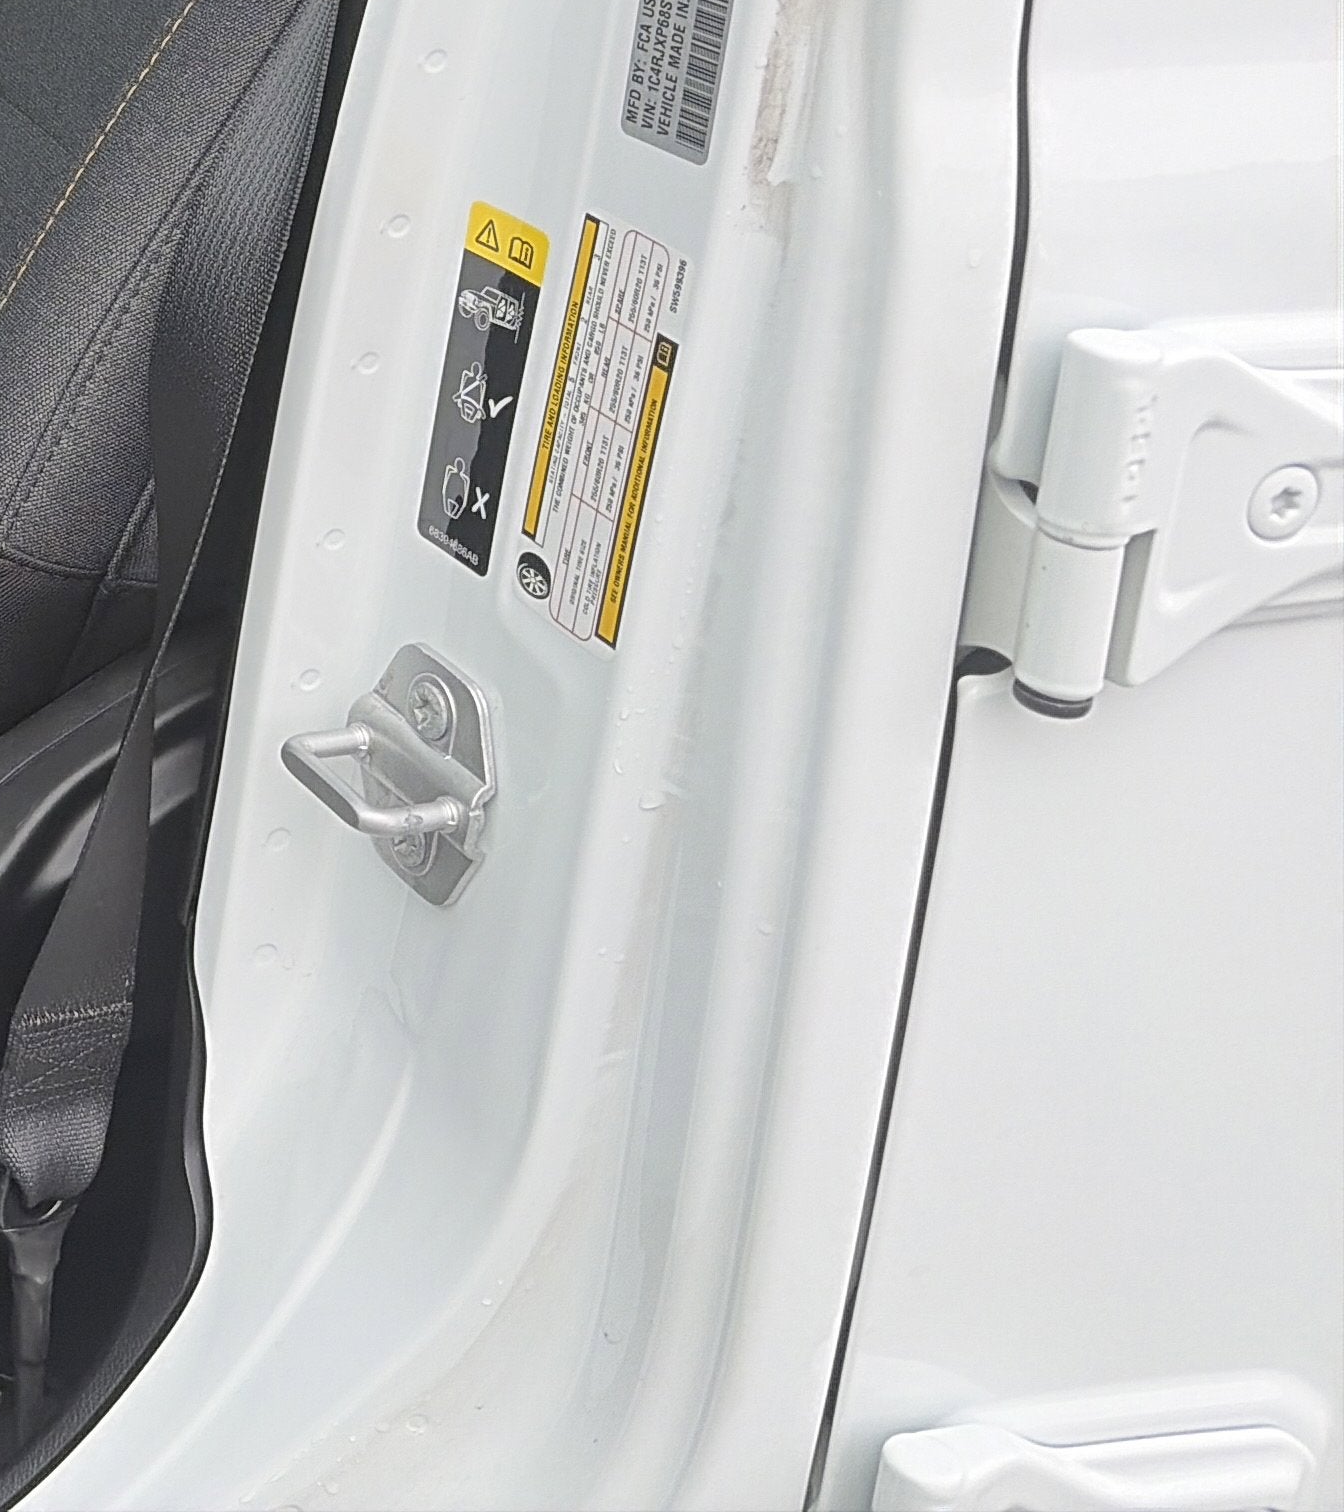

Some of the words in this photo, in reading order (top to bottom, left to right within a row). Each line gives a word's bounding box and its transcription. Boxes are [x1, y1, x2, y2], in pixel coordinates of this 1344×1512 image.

[636, 20, 652, 53] FCA
[631, 57, 646, 85] BY:
[656, 71, 678, 138] VEHICLE
[667, 22, 685, 69] MADE
[625, 87, 641, 123] MFD
[640, 96, 656, 131] VIN:
[605, 226, 616, 260] EXCEED
[598, 258, 610, 287] NEVER
[636, 253, 648, 276] 113T
[592, 286, 603, 320] SHOULD
[613, 287, 625, 315] SPARE
[559, 299, 578, 365] INFORMATION
[586, 319, 597, 348] CARGO
[582, 347, 592, 366] AND
[617, 344, 628, 367] 113T
[551, 364, 564, 407] LOADING
[572, 366, 587, 413] OCCUPANTS
[545, 405, 557, 428] AND
[640, 397, 657, 454] INFORMATION
[540, 428, 552, 451] TIRE
[563, 425, 575, 456] WEIGHT
[581, 440, 593, 467] FRONT
[555, 455, 568, 497] COMBINED
[630, 454, 644, 500] ADDITIONAL
[551, 497, 561, 513] THE
[626, 500, 636, 519] FOR
[620, 519, 631, 553] MANUAL
[613, 553, 624, 588] OWNERS
[609, 588, 618, 604] SEE
